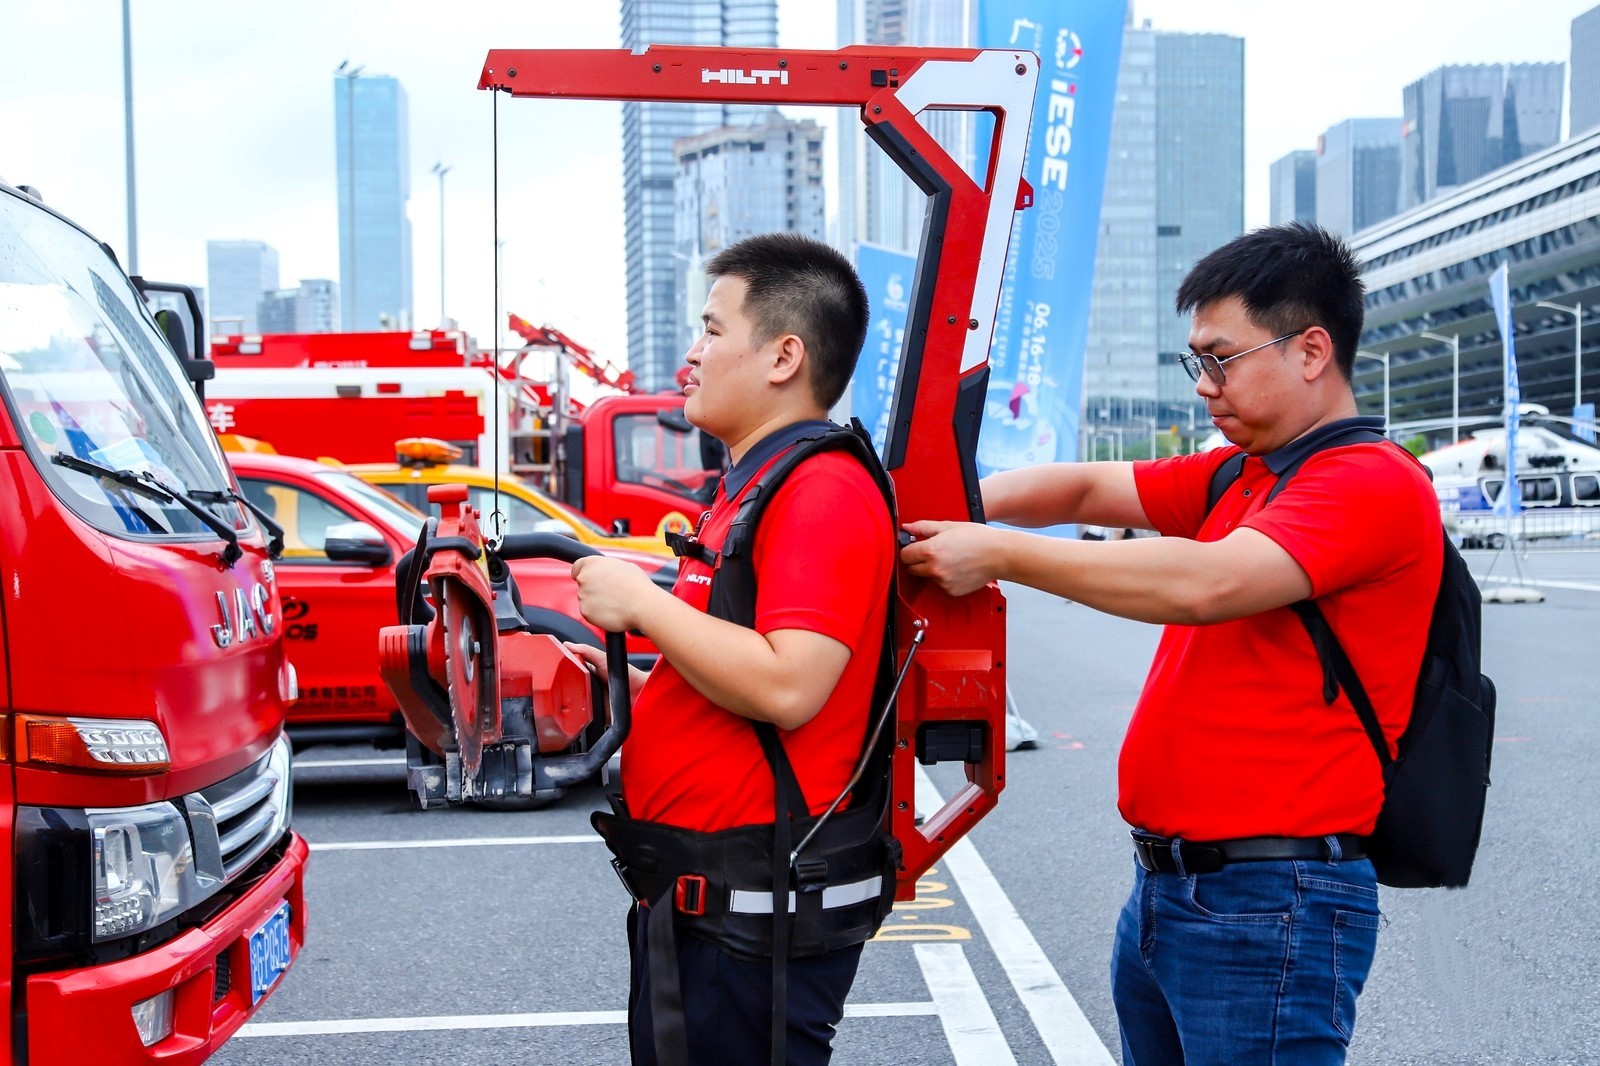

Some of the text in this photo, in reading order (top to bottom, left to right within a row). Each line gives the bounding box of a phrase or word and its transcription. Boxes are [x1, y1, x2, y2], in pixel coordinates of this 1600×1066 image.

[701, 68, 789, 85] HILTI
[1031, 78, 1077, 280] iESE 2025
[1000, 286, 1014, 332] SAFETY
[995, 336, 1008, 367] EXPO
[1026, 303, 1051, 387] 06.16-18
[208, 403, 235, 432] 车
[209, 582, 274, 649] JAC
[161, 826, 174, 837] JAC
